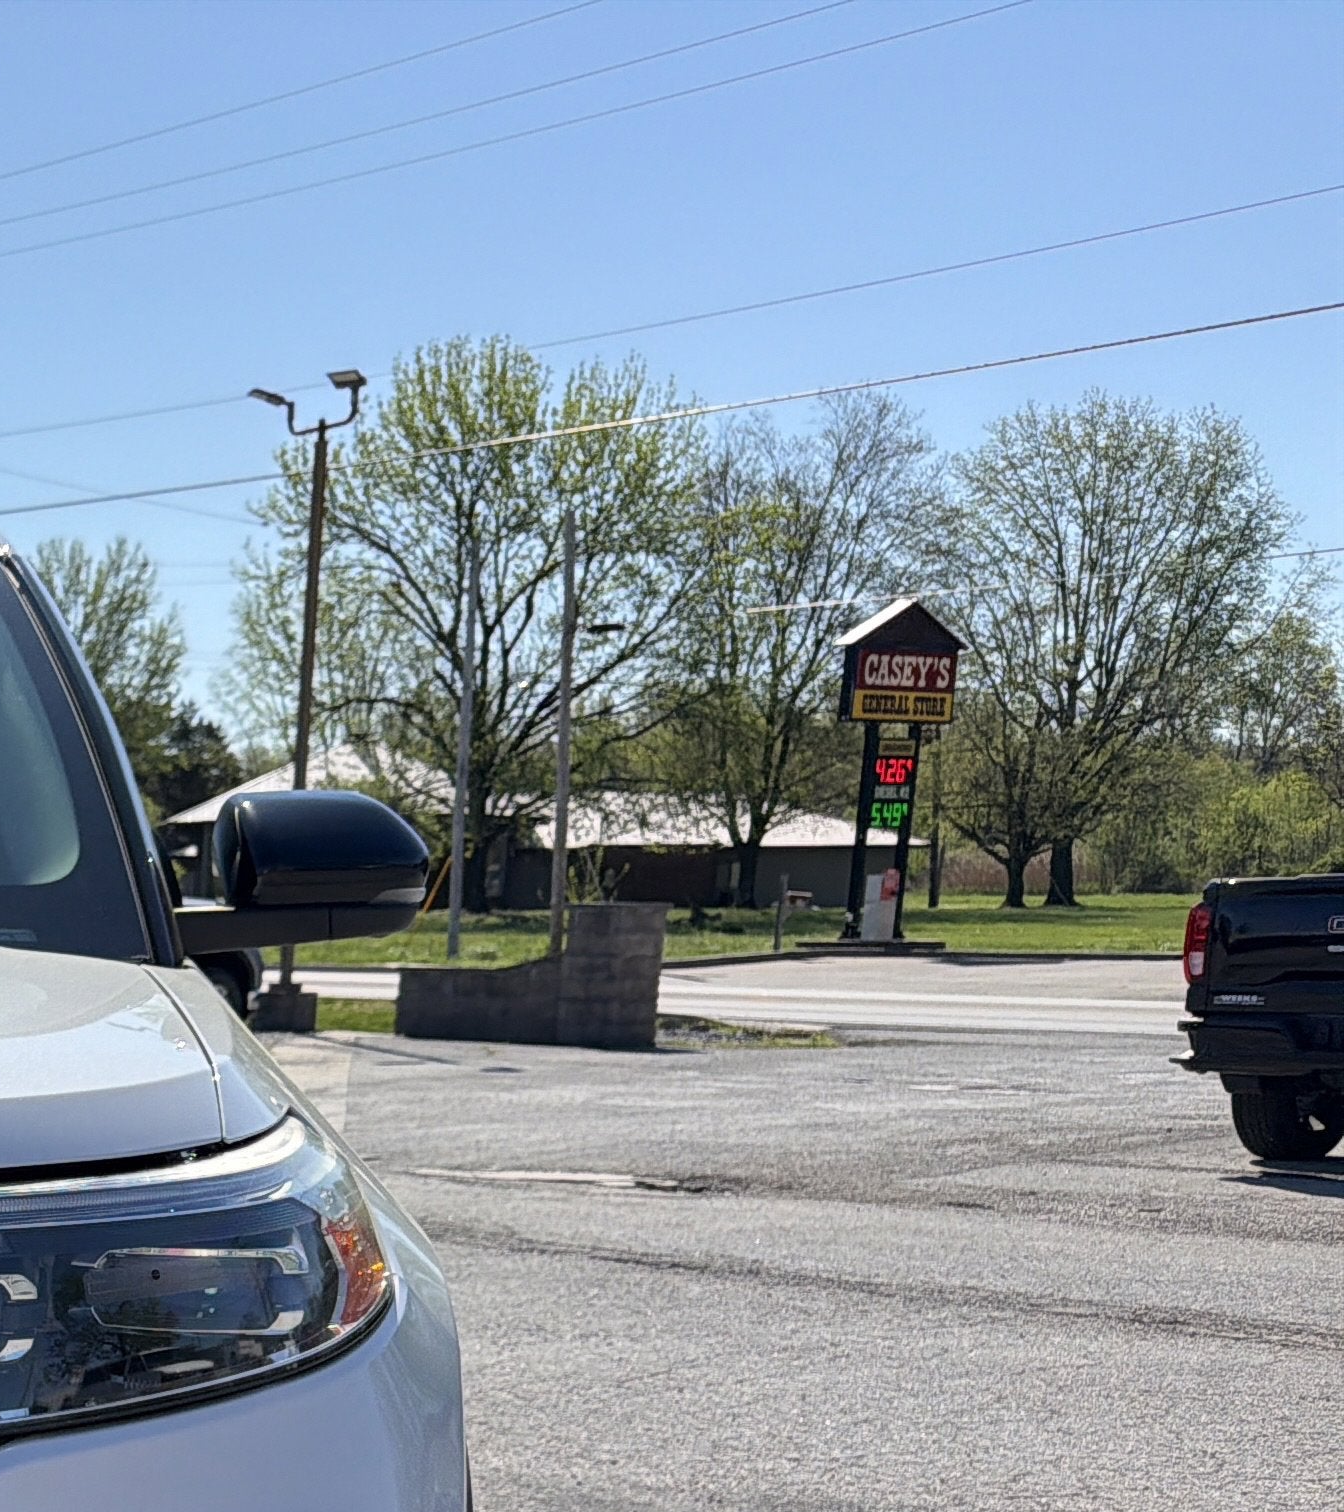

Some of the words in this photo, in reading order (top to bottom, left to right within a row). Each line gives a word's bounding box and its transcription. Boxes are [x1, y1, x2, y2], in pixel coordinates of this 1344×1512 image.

[864, 653, 951, 689] CASEY'S
[862, 693, 910, 716] GENERAL
[912, 696, 947, 717] STORE
